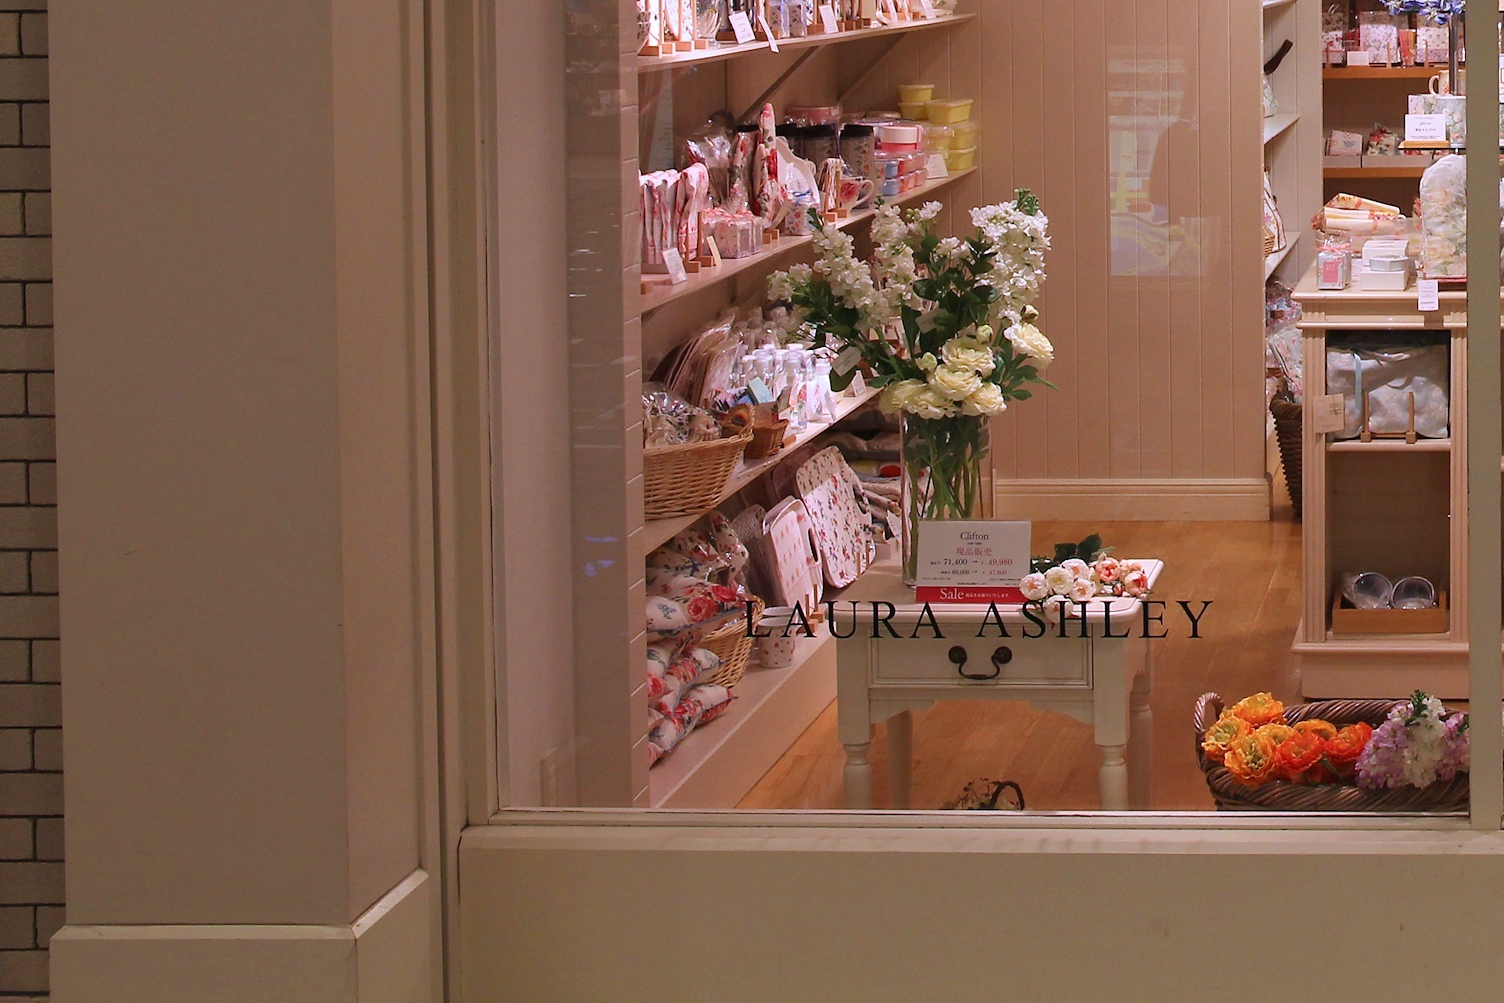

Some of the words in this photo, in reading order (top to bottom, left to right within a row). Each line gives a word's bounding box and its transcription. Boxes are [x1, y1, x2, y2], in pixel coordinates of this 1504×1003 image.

[960, 531, 989, 540] Clifton
[943, 558, 968, 566] 71,400
[988, 558, 1013, 566] 49,980
[939, 587, 965, 600] Sale
[745, 598, 947, 639] LAURA
[975, 598, 1214, 639] ASHLEY
